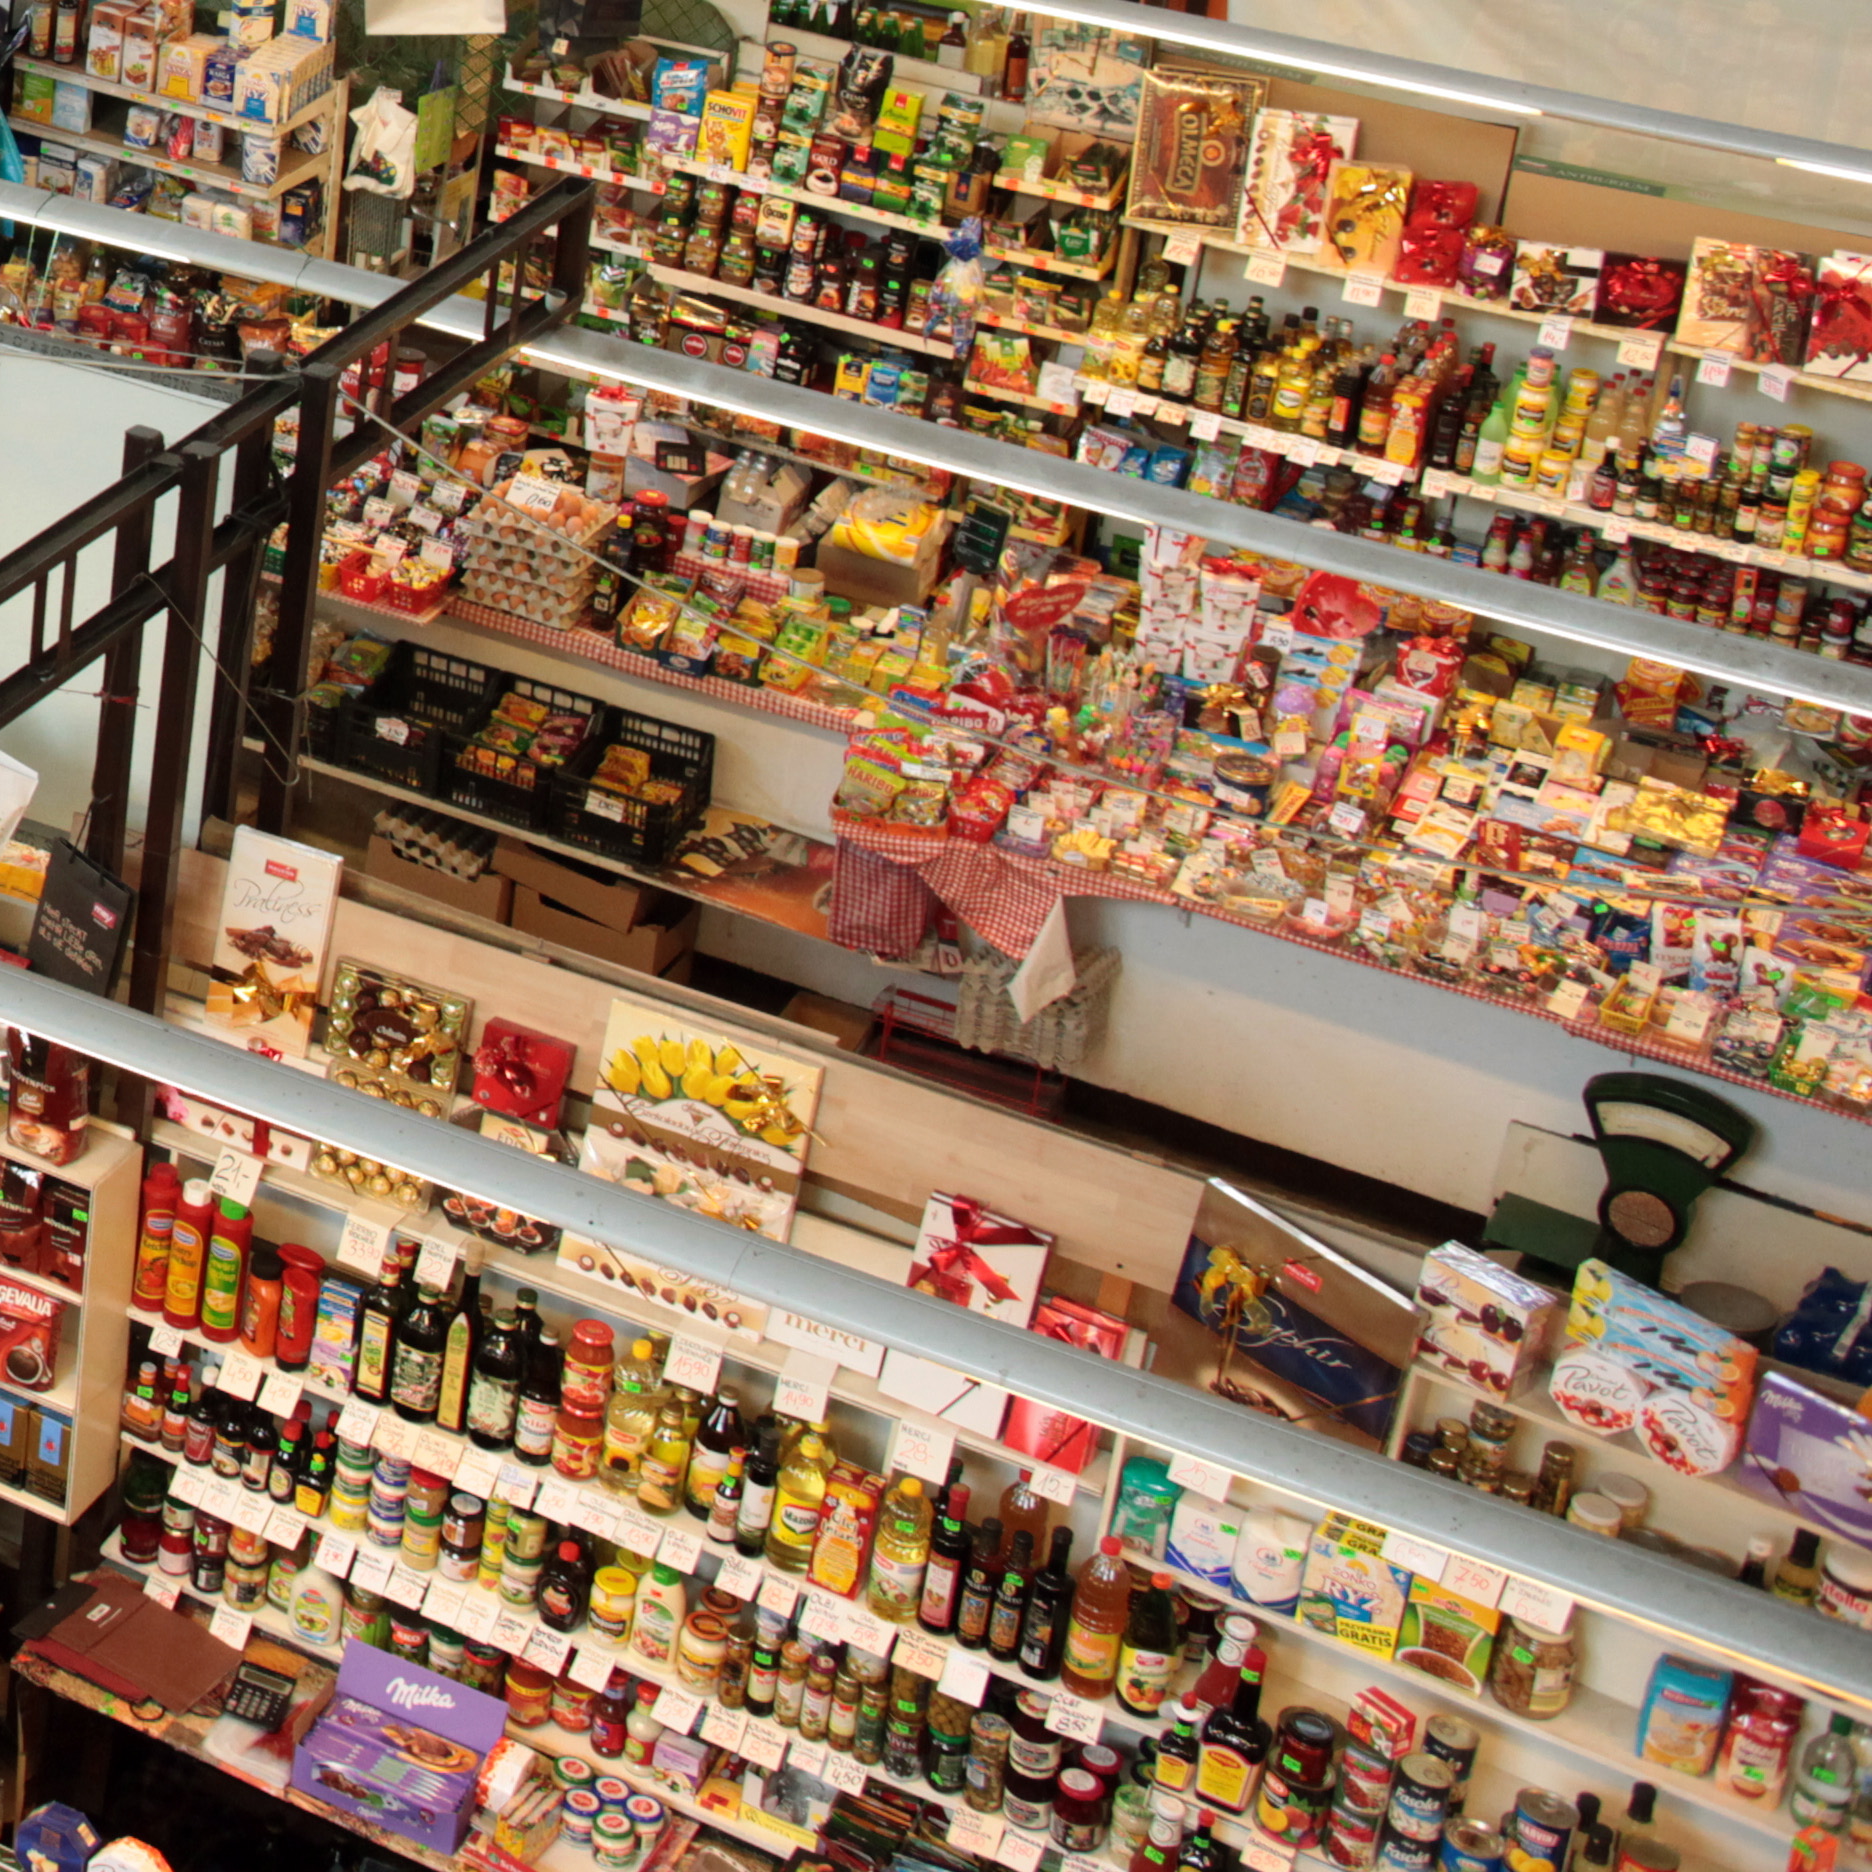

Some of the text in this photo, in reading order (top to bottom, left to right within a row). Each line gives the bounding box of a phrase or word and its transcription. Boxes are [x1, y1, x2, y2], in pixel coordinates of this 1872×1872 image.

[707, 100, 747, 121] SCHOVIT
[1174, 112, 1198, 187] OLMECA
[845, 764, 895, 795] HARIBO
[783, 1311, 869, 1354] merci
[779, 1376, 810, 1394] MERCI
[1554, 1363, 1630, 1401] Pavot
[900, 1422, 932, 1442] MERCI
[1653, 1395, 1721, 1462] Pavot
[783, 1508, 819, 1527] Mazola
[1331, 1562, 1377, 1590] SONKO
[1456, 1566, 1491, 1591] 7,50
[1320, 1576, 1384, 1615] RYŻ
[1339, 1629, 1393, 1651] GRATIS
[386, 1676, 456, 1710] Milka
[832, 1769, 863, 1788] 4,50
[1394, 1784, 1442, 1812] Fasola
[1386, 1840, 1432, 1866] Fasola
